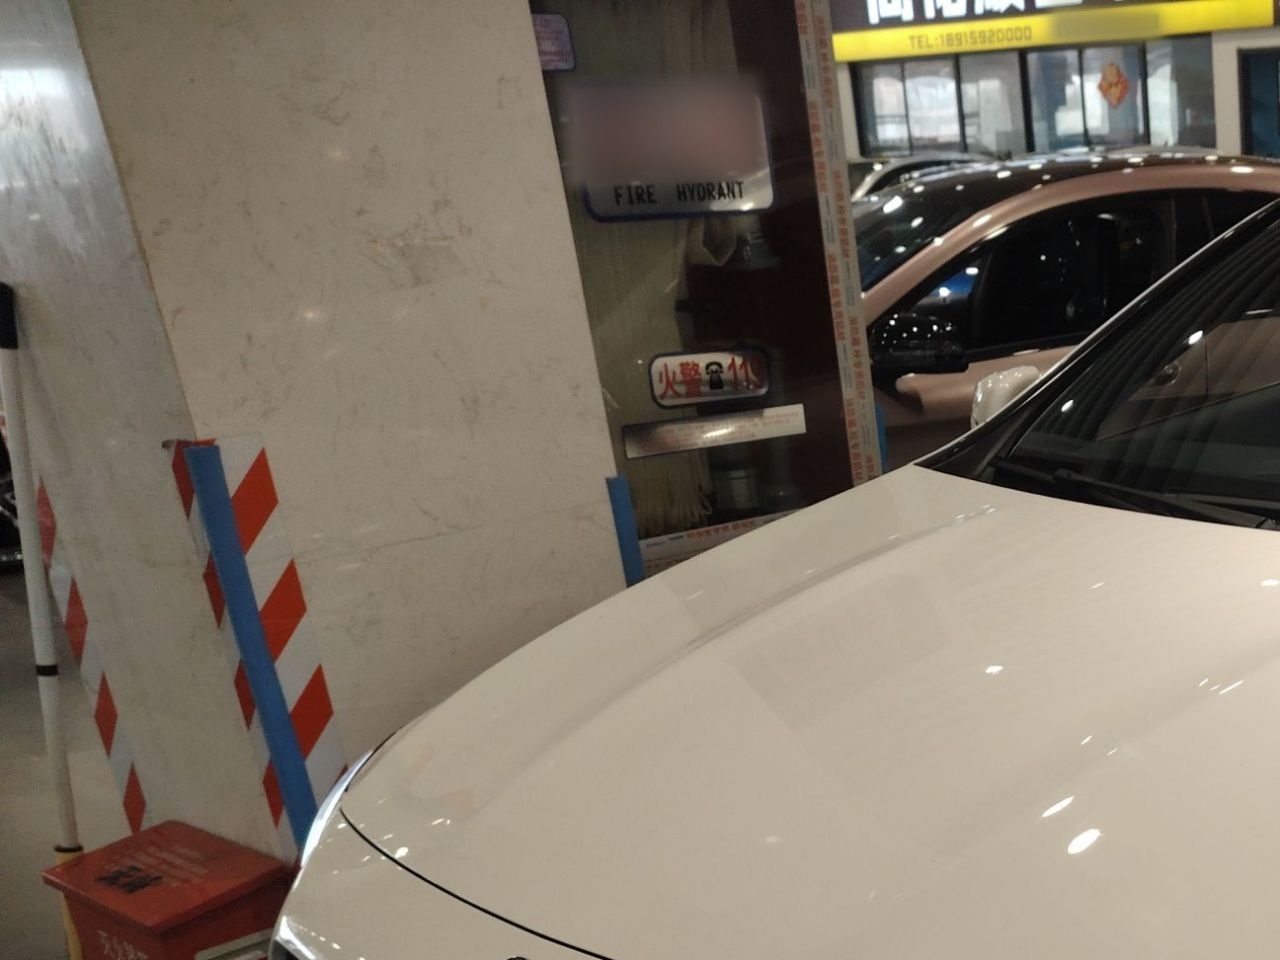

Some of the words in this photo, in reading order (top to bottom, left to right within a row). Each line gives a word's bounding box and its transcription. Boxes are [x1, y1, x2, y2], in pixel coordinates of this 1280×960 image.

[613, 184, 658, 206] FIRE
[675, 180, 745, 203] HYDRANT
[658, 359, 703, 400] 火警
